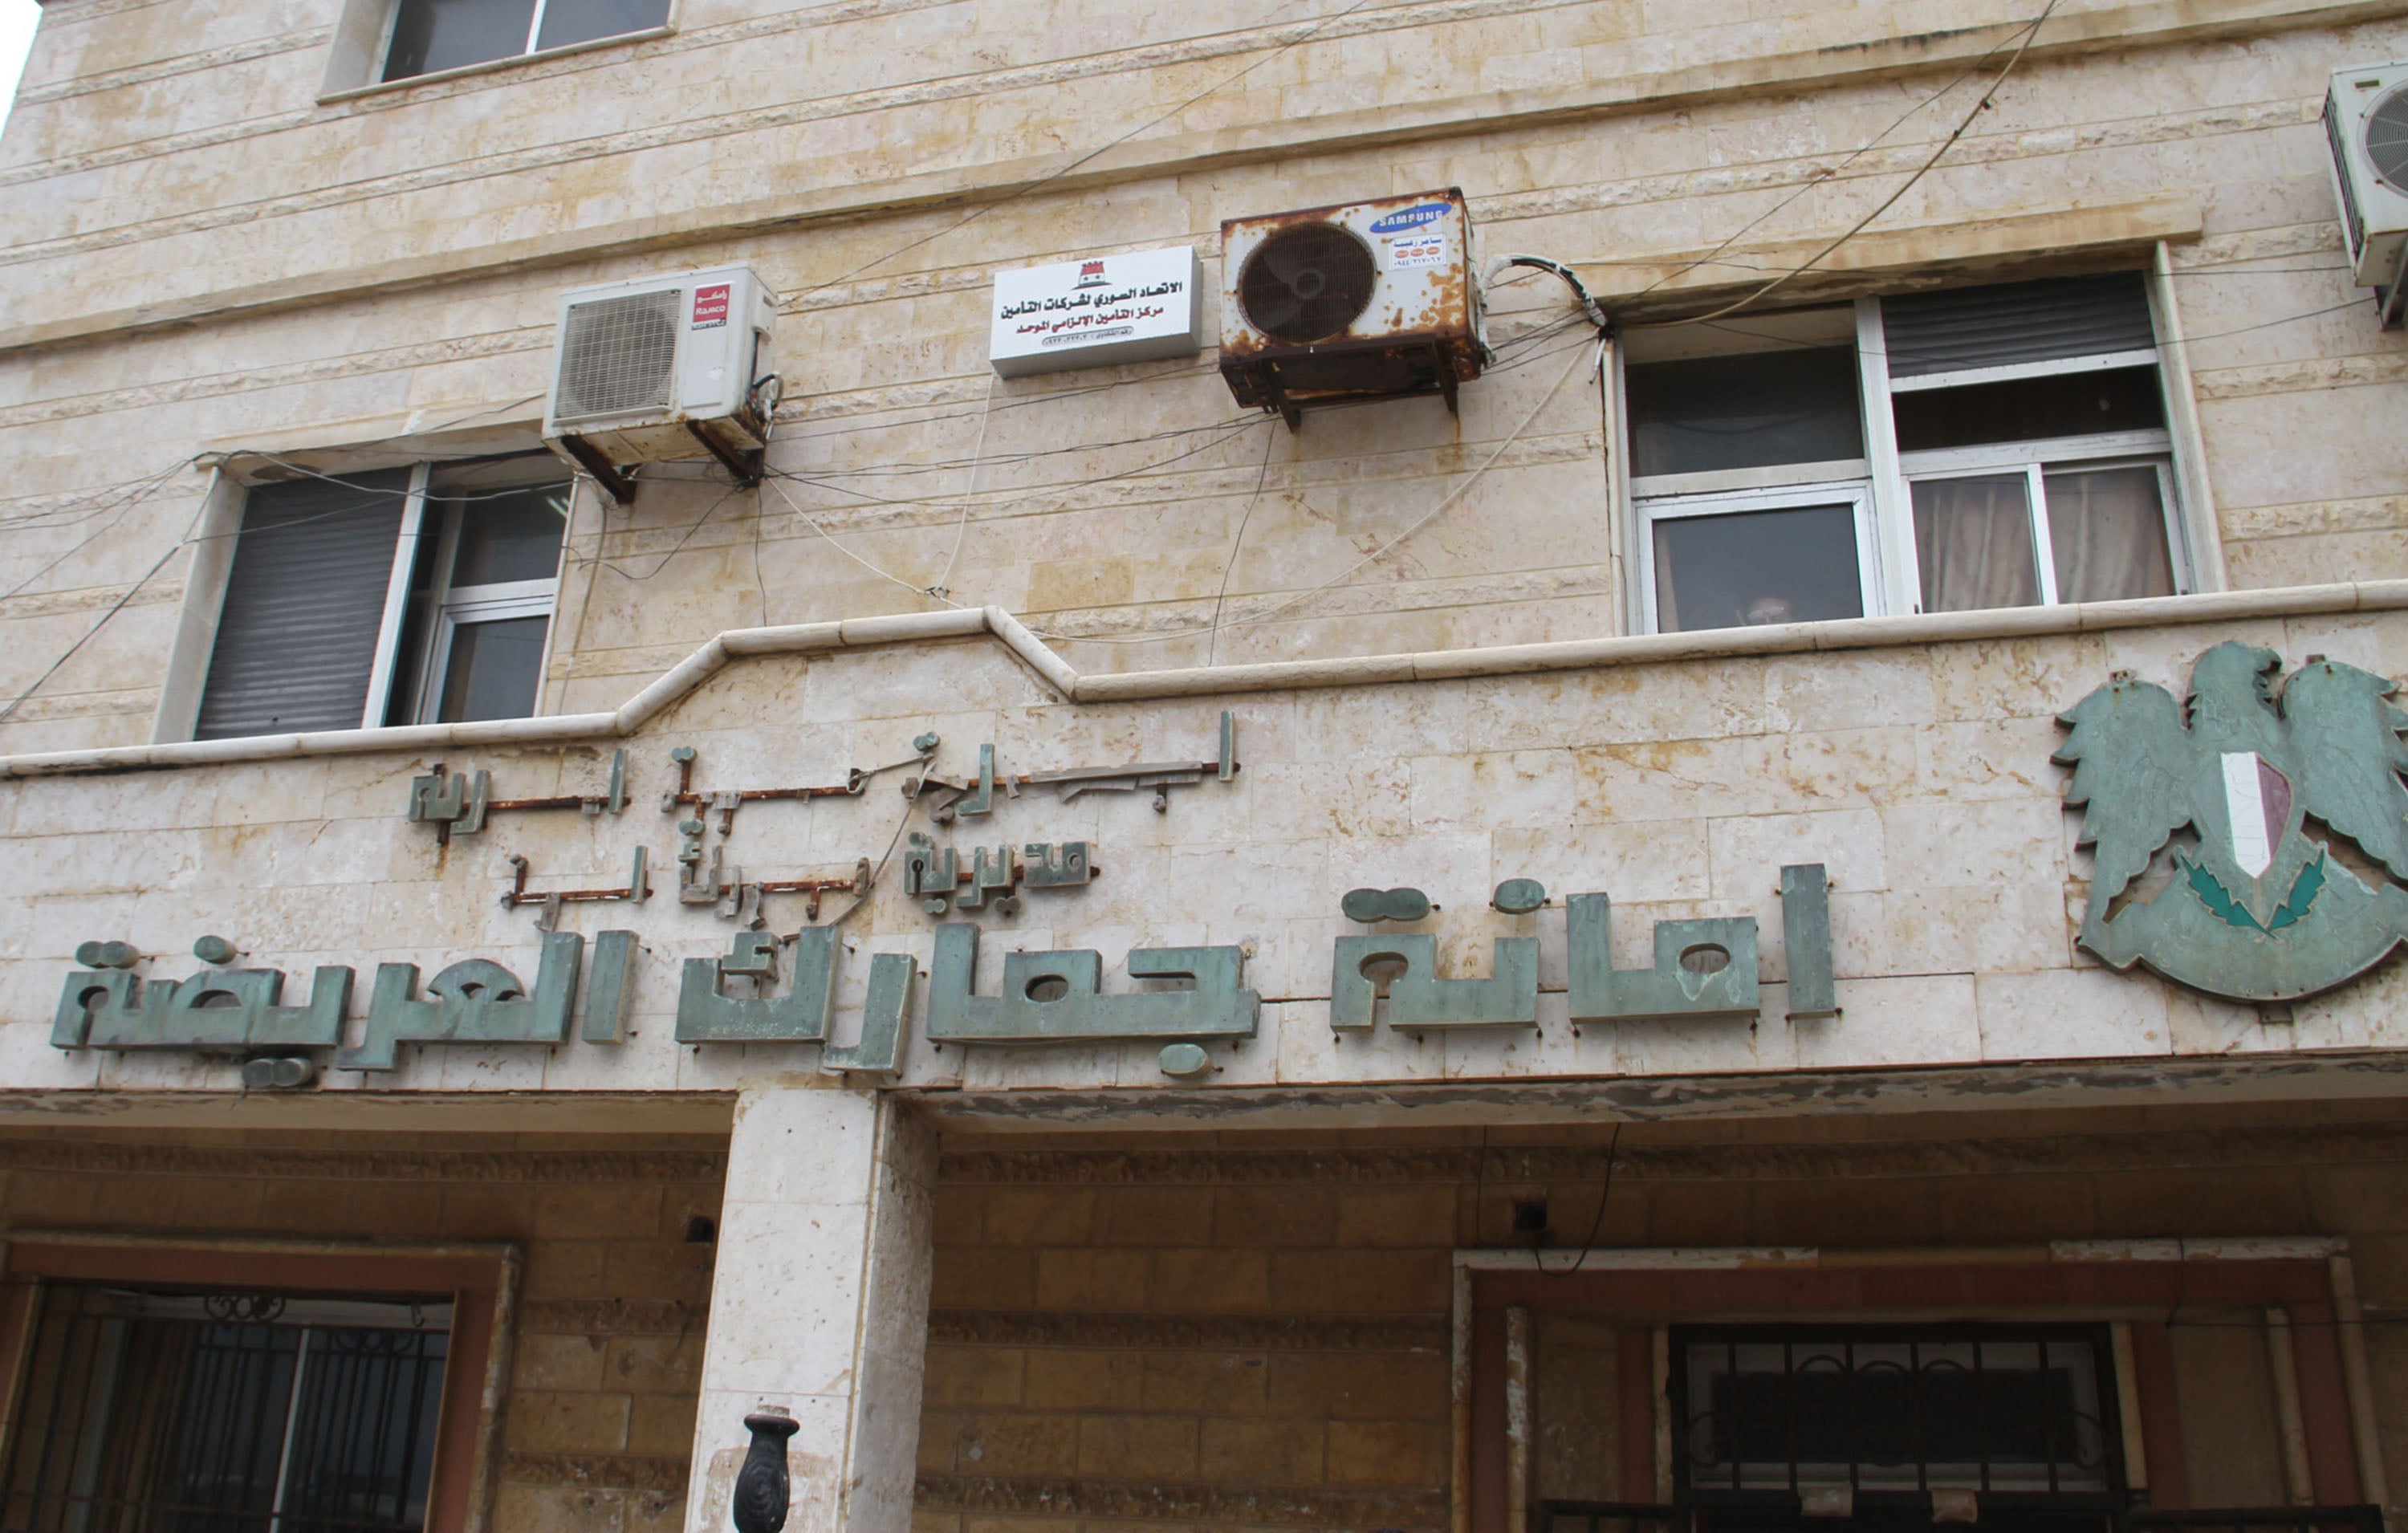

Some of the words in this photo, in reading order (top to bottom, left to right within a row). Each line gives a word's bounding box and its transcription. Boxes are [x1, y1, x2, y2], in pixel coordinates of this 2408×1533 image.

[1378, 209, 1443, 227] SAMSUNG
[1094, 288, 1137, 307] السوري
[1140, 281, 1182, 298] الاتحاد
[1001, 299, 1042, 319] التأمين
[1043, 293, 1091, 311] لشركات
[1095, 308, 1134, 324] التأمين
[1135, 306, 1164, 319] مركز
[1016, 320, 1050, 334] الموحد
[904, 832, 1092, 916] مديرية
[1328, 862, 1837, 1034] امانة
[50, 929, 642, 1088] العريضة
[673, 922, 1261, 1080] جمارك
